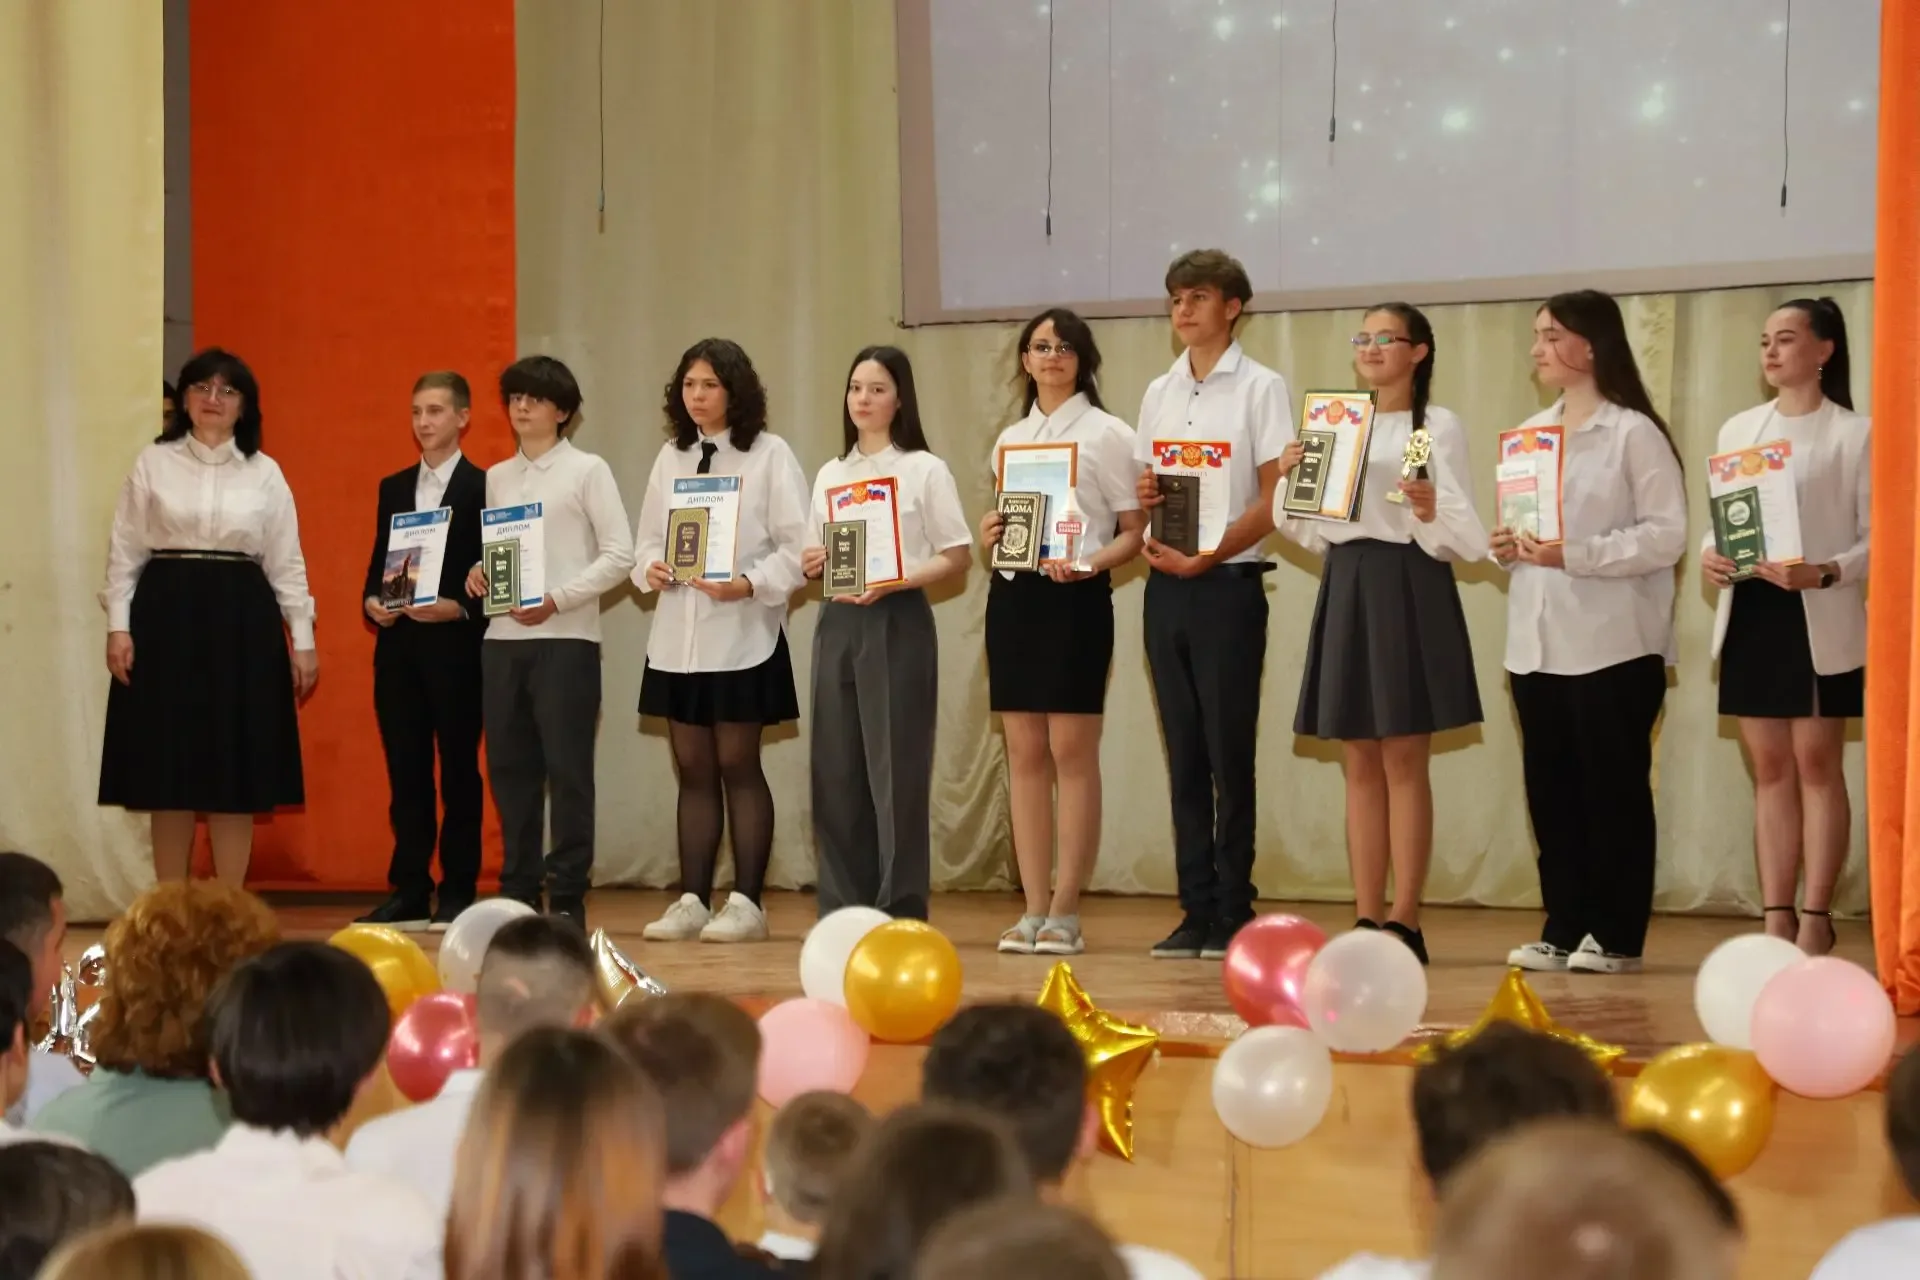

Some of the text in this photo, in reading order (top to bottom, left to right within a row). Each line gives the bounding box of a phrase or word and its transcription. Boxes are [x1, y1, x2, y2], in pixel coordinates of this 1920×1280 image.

[686, 495, 724, 504] ДИПЛОМ
[1003, 504, 1032, 514] ДЮМА
[403, 529, 436, 538] ДИПЛОМ
[496, 524, 531, 536] ДИПЛОМ
